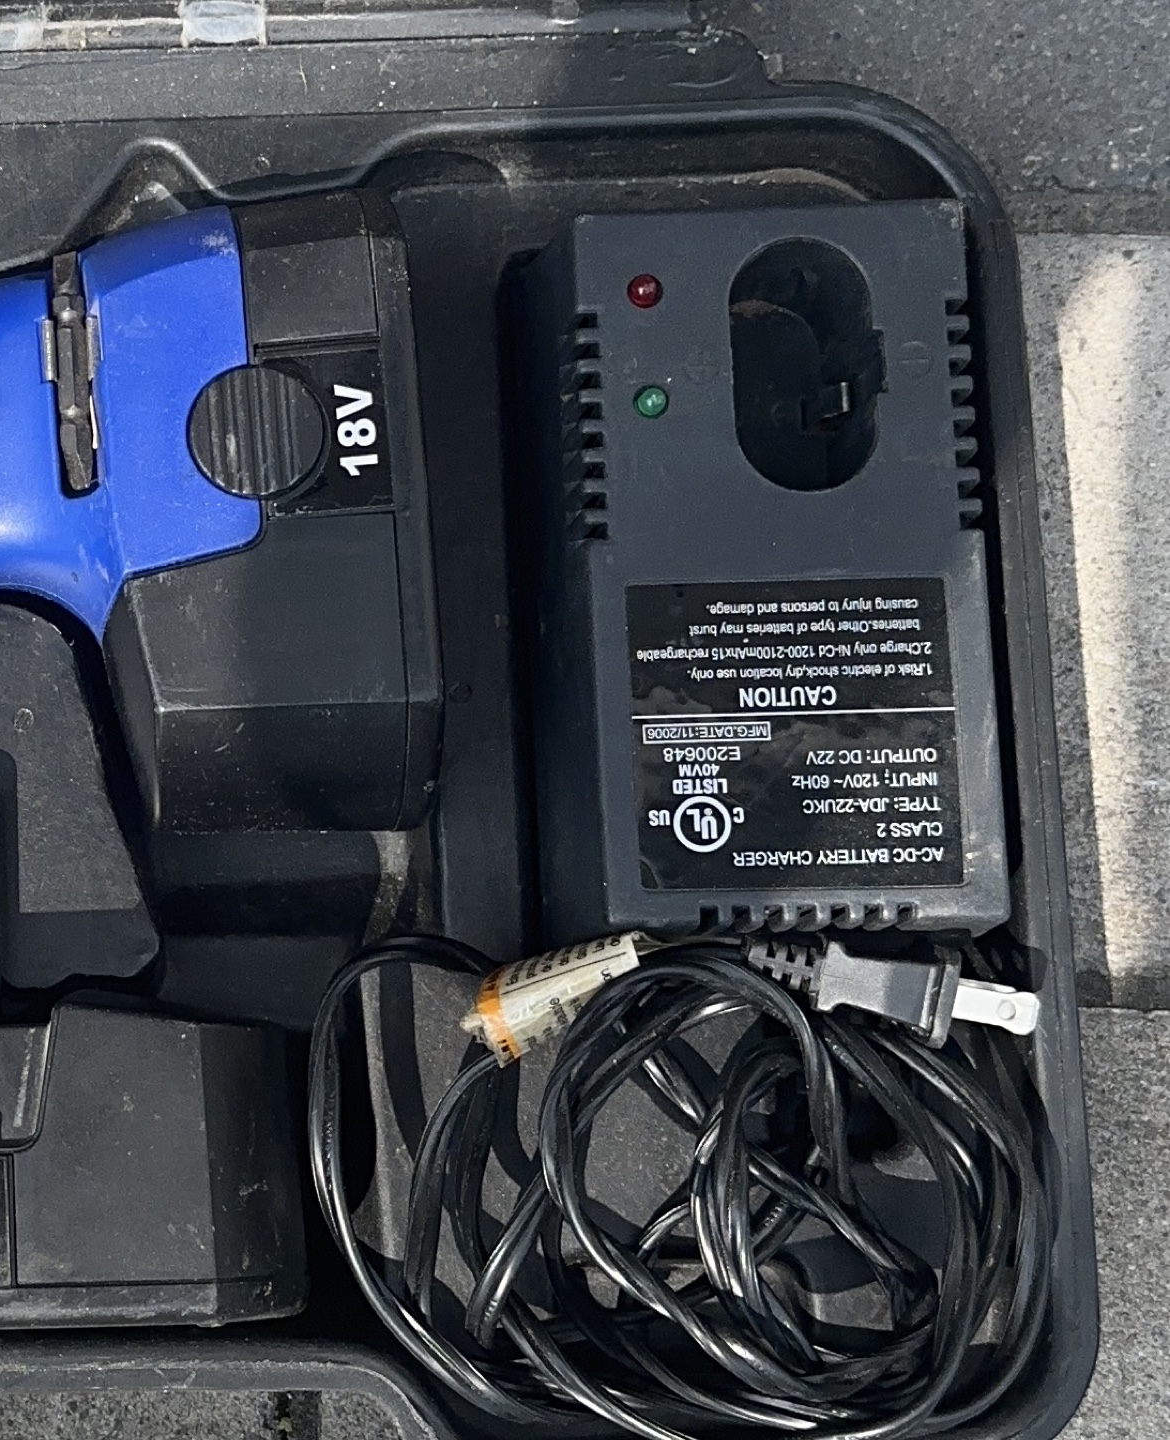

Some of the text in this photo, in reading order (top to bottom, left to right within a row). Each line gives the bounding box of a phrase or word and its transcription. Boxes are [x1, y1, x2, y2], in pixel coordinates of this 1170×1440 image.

[334, 384, 379, 478] 18V
[706, 596, 918, 617] causing injury to persons and damage.
[689, 618, 920, 637] batteries.Other type of batteries may burst
[637, 640, 932, 661] 2.Charge only Ni-Cd 1200-2100mAhx15 rechargeable
[687, 663, 932, 681] 1.Risk of electric shock,dry location use only.
[739, 686, 837, 707] CAUTION
[663, 746, 741, 762] E200648
[805, 747, 937, 765] OUTPUT: DC 22V
[678, 763, 720, 776] 40VM
[672, 778, 728, 794] LISTED
[791, 774, 829, 788] 60Hz
[834, 773, 880, 788] 120V~
[802, 796, 941, 813] TYPE: JDA-22UKC
[649, 810, 670, 826] US
[686, 808, 718, 839] UL
[876, 821, 942, 837] CLASS 2
[733, 847, 944, 866] AC-DC BATTERY CHARGER
